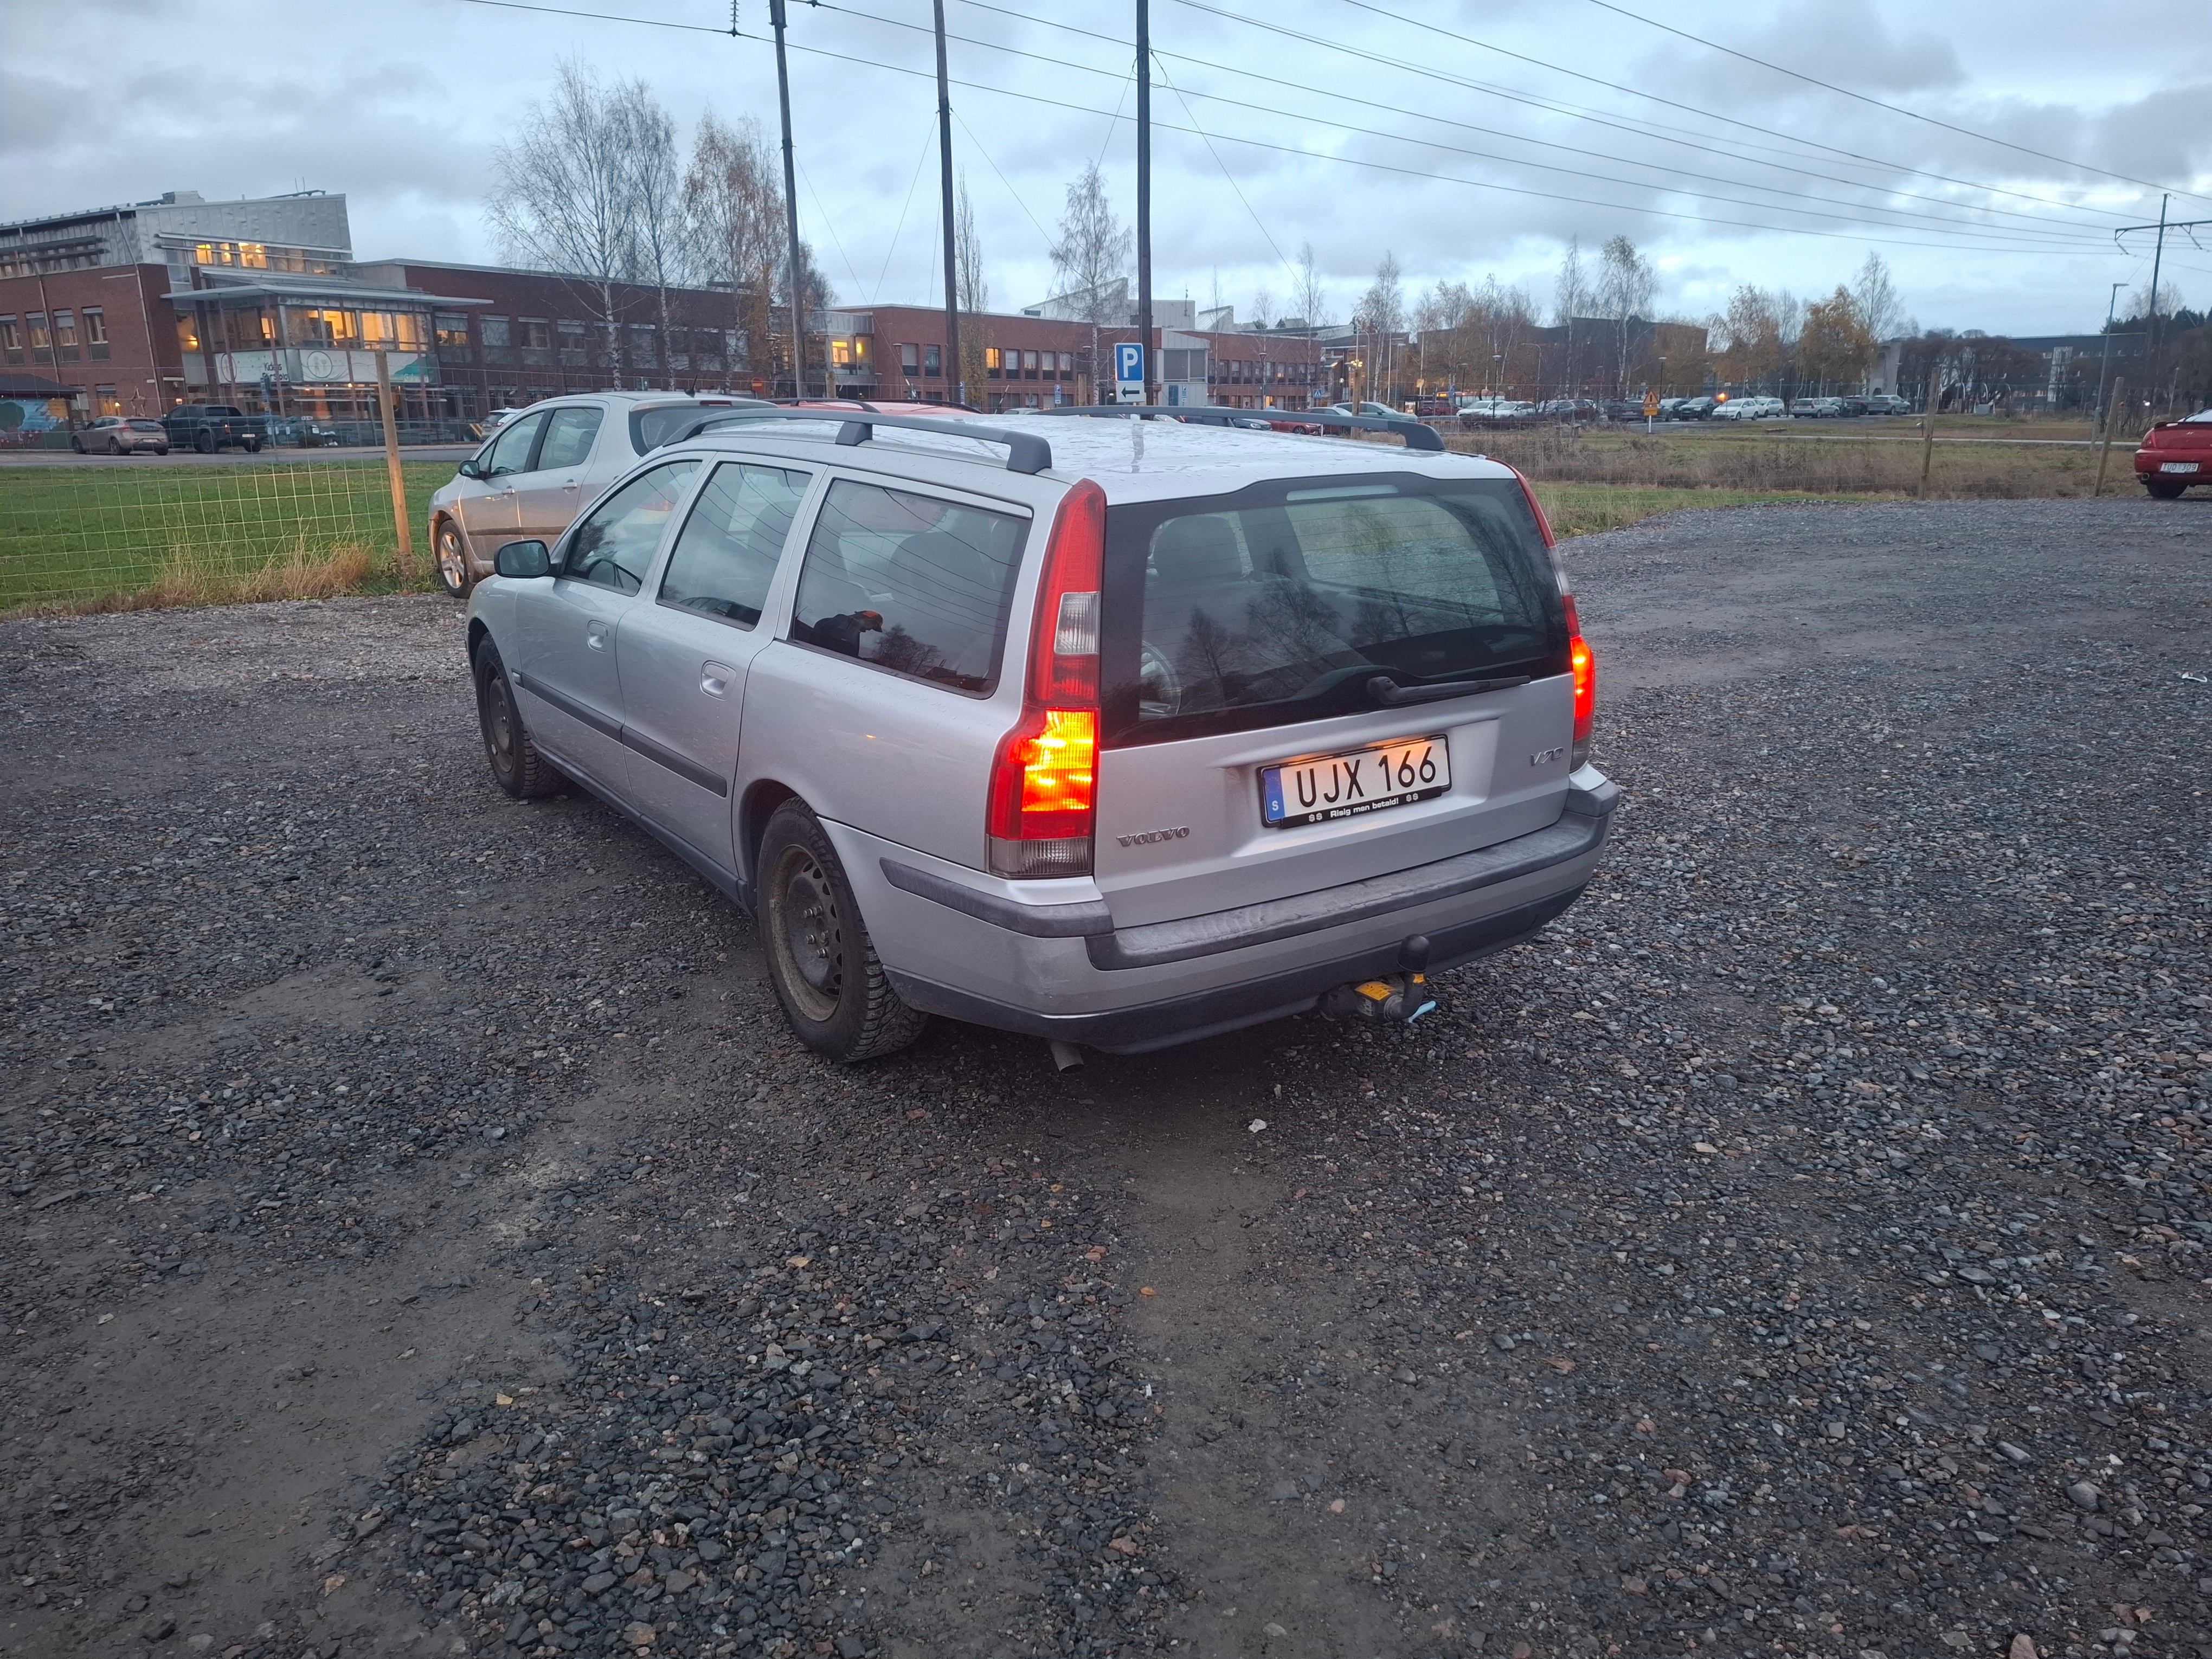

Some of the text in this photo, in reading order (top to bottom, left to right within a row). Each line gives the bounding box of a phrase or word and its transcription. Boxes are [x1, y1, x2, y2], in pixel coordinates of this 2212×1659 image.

[1123, 348, 1138, 378] P
[1531, 747, 1564, 766] V70
[1296, 746, 1436, 807] UJX 166
[1272, 800, 1279, 811] S
[1330, 808, 1351, 818] Risig
[1353, 805, 1370, 813] men
[1372, 797, 1399, 809] betald!
[1116, 826, 1190, 847] VOLVO
